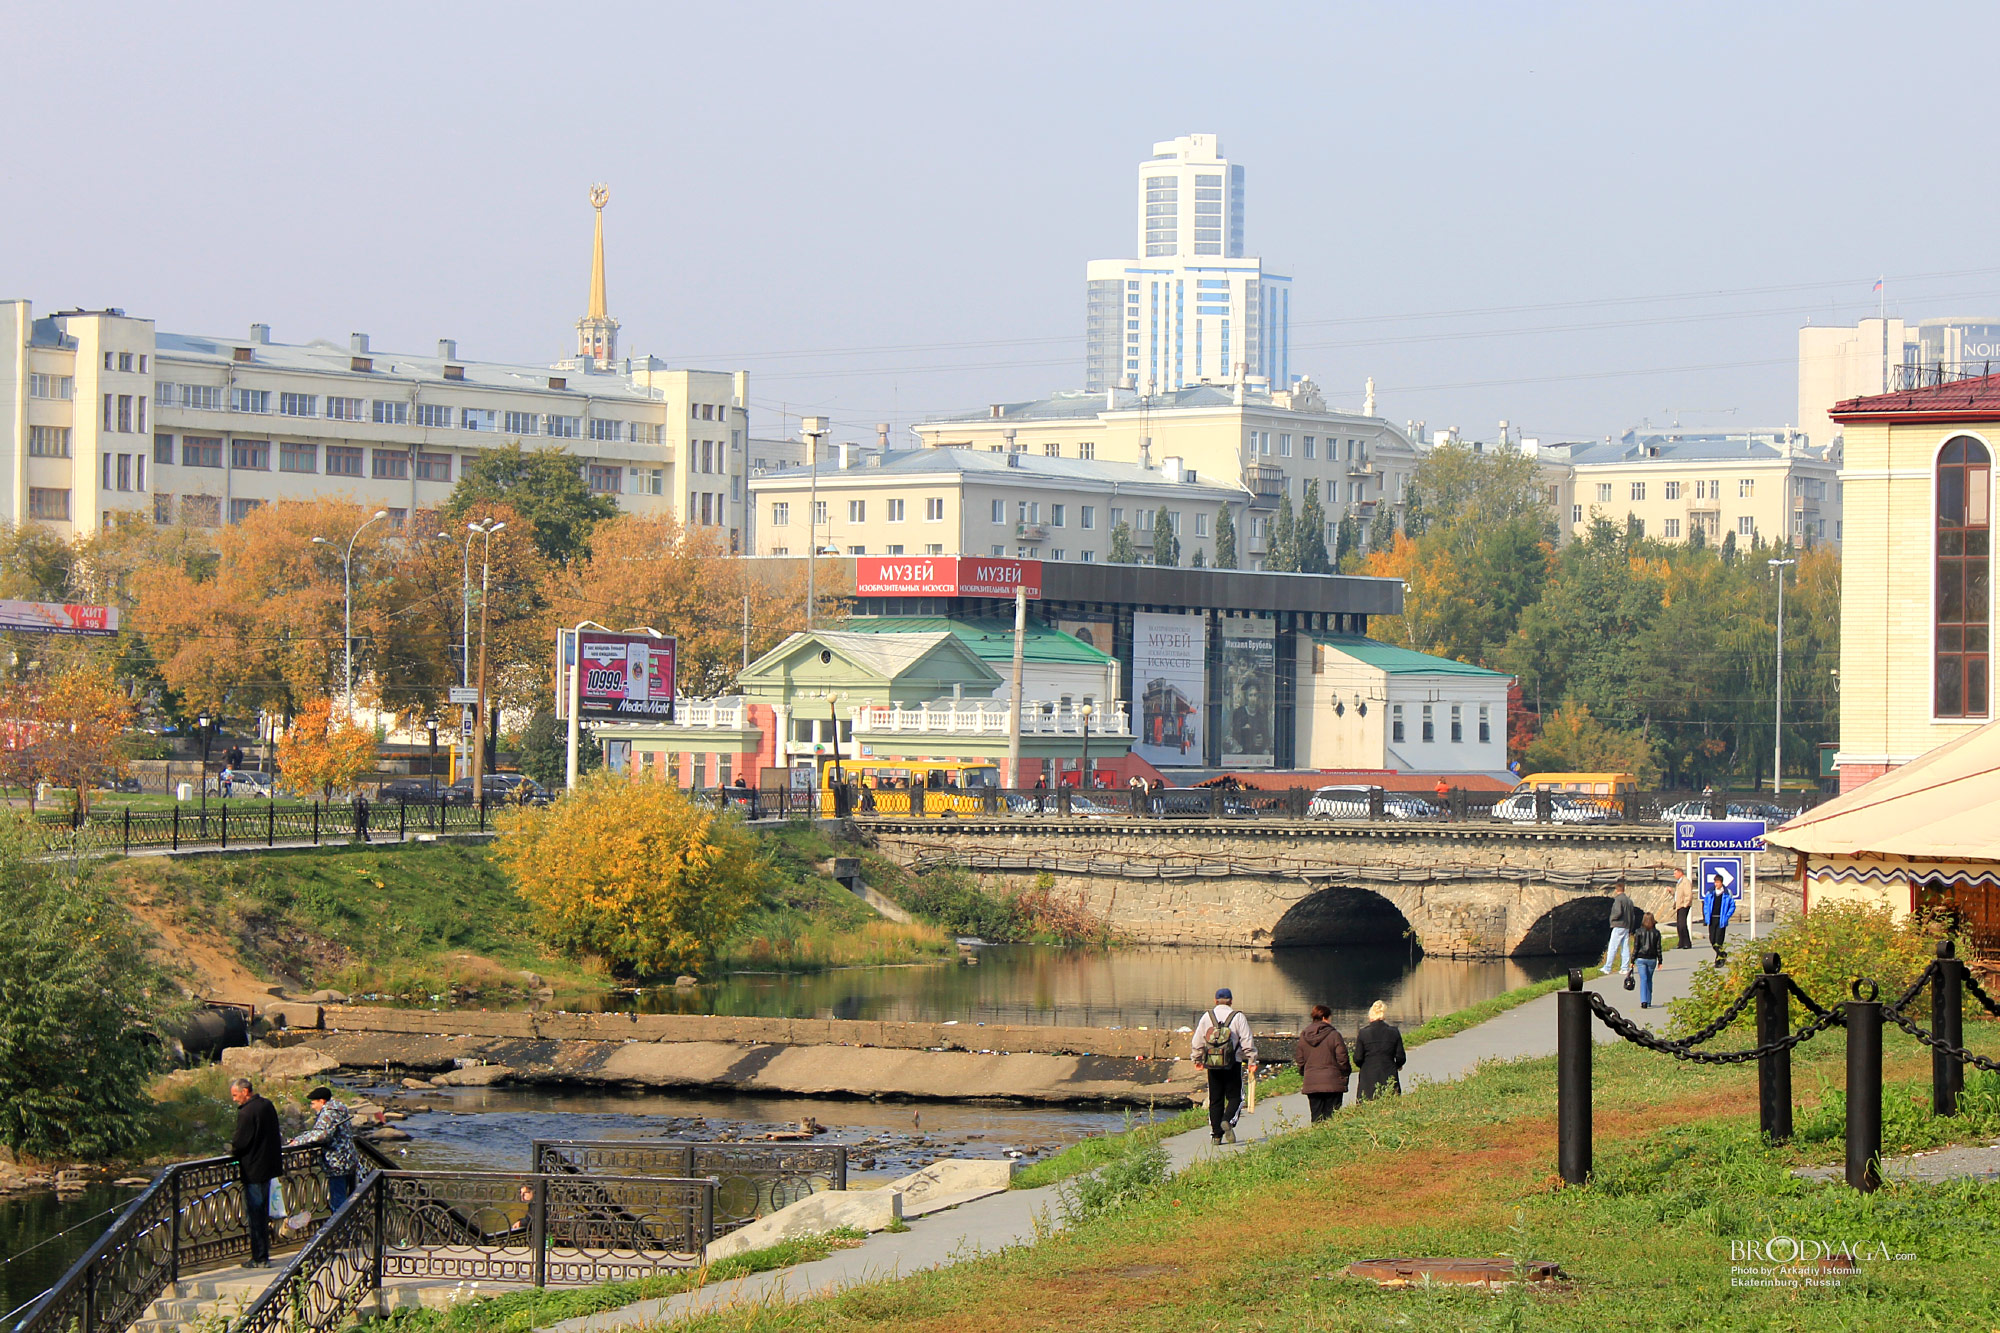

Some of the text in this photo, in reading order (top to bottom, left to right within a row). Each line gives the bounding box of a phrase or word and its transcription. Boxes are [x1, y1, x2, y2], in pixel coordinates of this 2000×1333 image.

[879, 560, 934, 581] МУЗЕЙ
[976, 562, 1022, 583] МУЗЕЙ
[858, 584, 955, 593] ИЗОБРАЗИТЕЛЬНЫХ ИСКУССТВ
[959, 584, 1038, 595] ИЗОБРАЗИТЕЛЬНЫХ ИССТВ
[81, 607, 104, 618] ХИТ
[85, 619, 100, 629] 195
[1148, 632, 1191, 650] МУЗЕЙ
[1225, 639, 1273, 652] Михаил Врубель
[1147, 657, 1191, 668] ИСКУССТВ
[618, 699, 643, 712] Media
[646, 700, 670, 714] Markt
